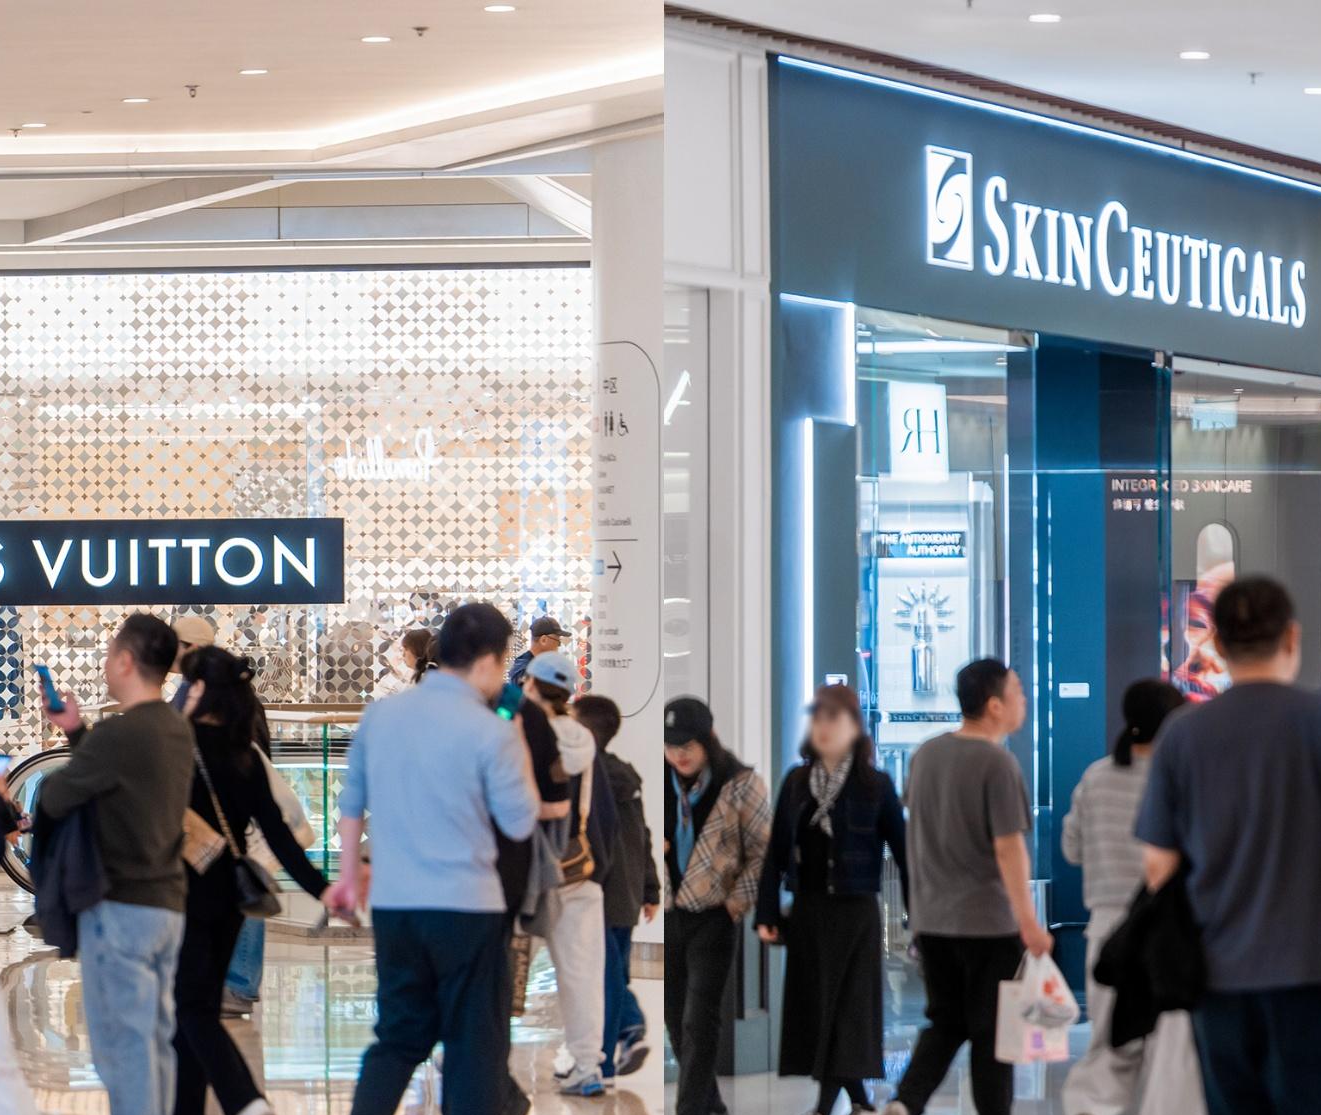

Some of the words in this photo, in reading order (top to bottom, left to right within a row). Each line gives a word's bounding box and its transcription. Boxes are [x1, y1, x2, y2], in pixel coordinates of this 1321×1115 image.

[1192, 479, 1252, 493] SKINCARE
[880, 533, 898, 545] THE
[907, 544, 961, 556] AUTHORITY
[32, 534, 316, 588] VUITTON
